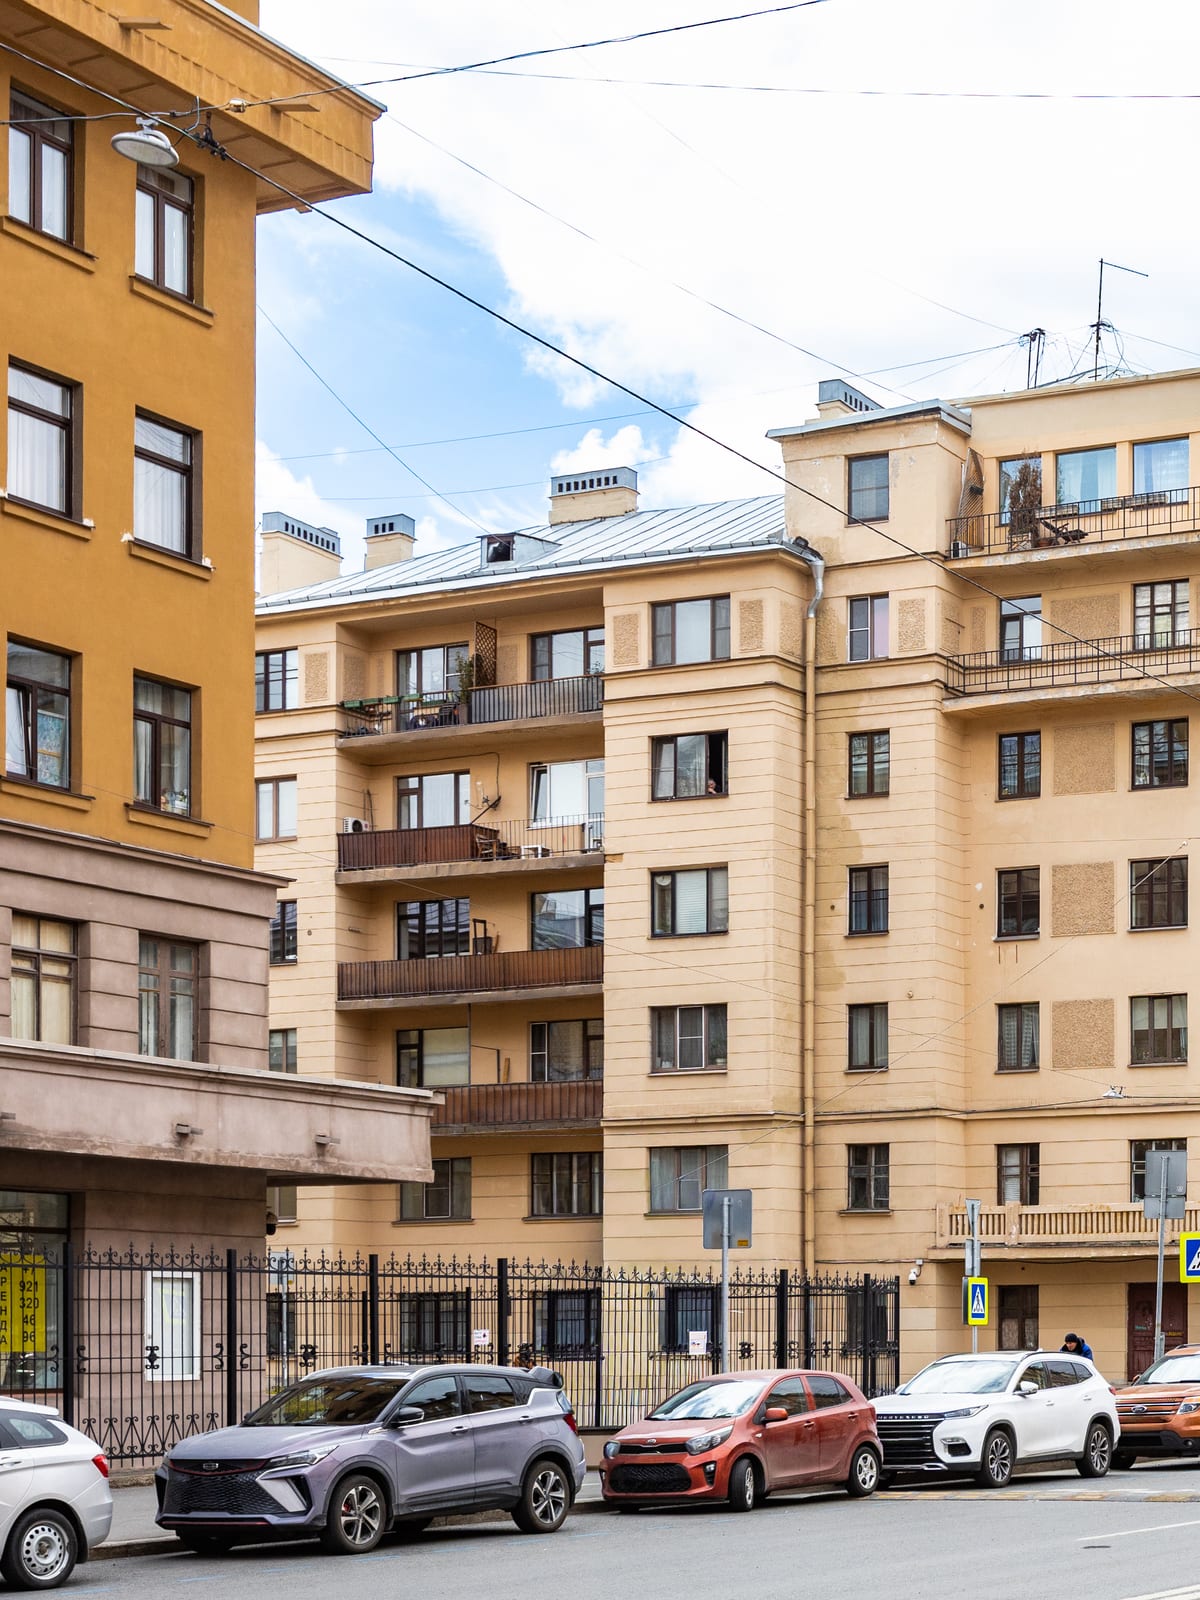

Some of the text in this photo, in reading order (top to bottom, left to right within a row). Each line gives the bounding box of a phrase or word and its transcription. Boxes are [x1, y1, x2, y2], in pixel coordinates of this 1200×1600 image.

[19, 1281, 38, 1292] 921
[19, 1297, 39, 1309] 320
[22, 1331, 36, 1343] 96
